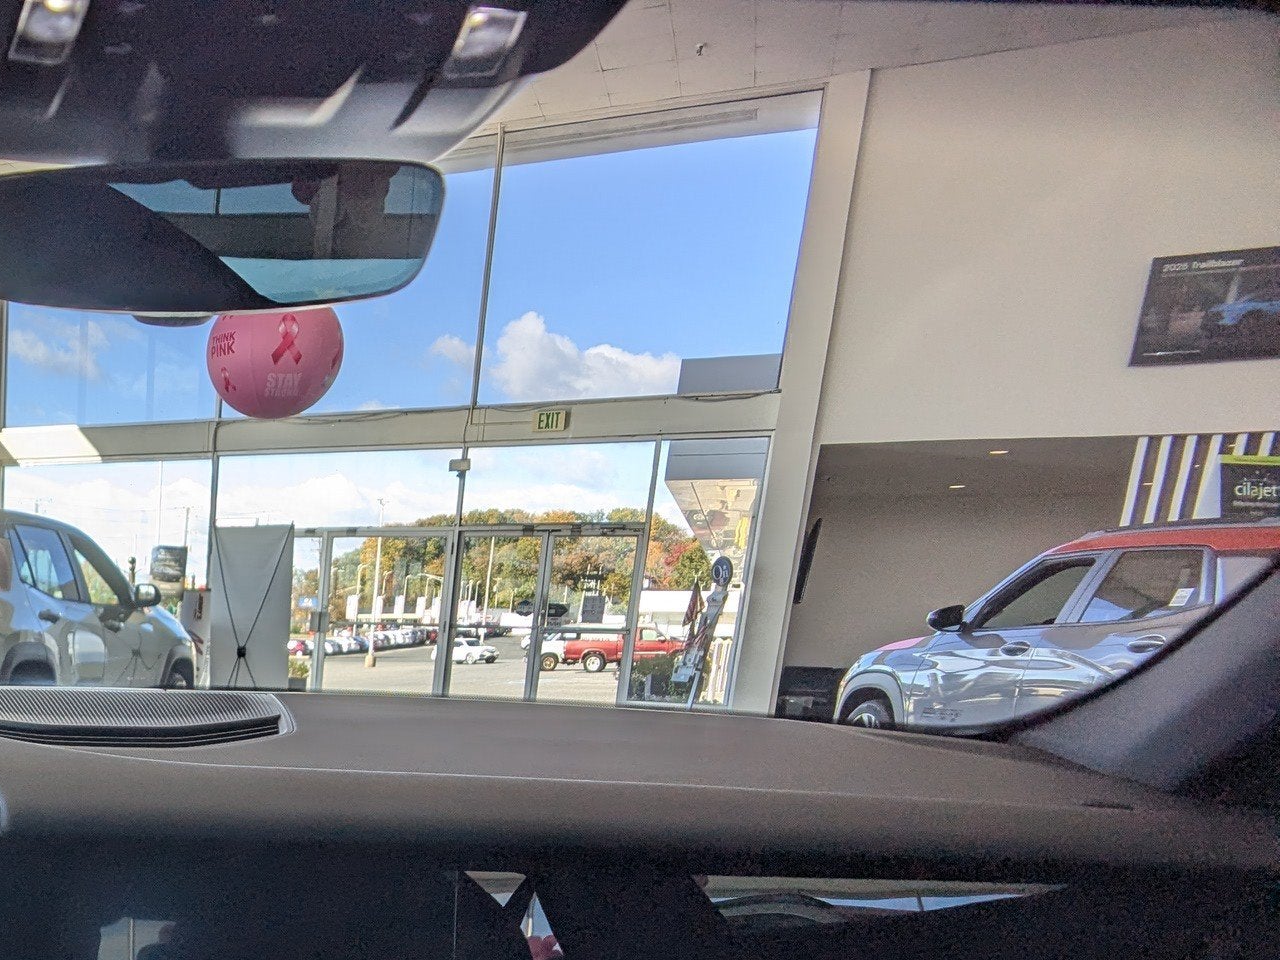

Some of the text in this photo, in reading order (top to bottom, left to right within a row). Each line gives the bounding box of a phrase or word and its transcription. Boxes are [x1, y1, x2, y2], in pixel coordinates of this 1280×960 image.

[212, 331, 236, 345] THINK
[211, 341, 235, 359] PINK
[266, 372, 302, 388] STAY
[538, 411, 561, 430] EXIT
[1234, 481, 1278, 499] cilajet
